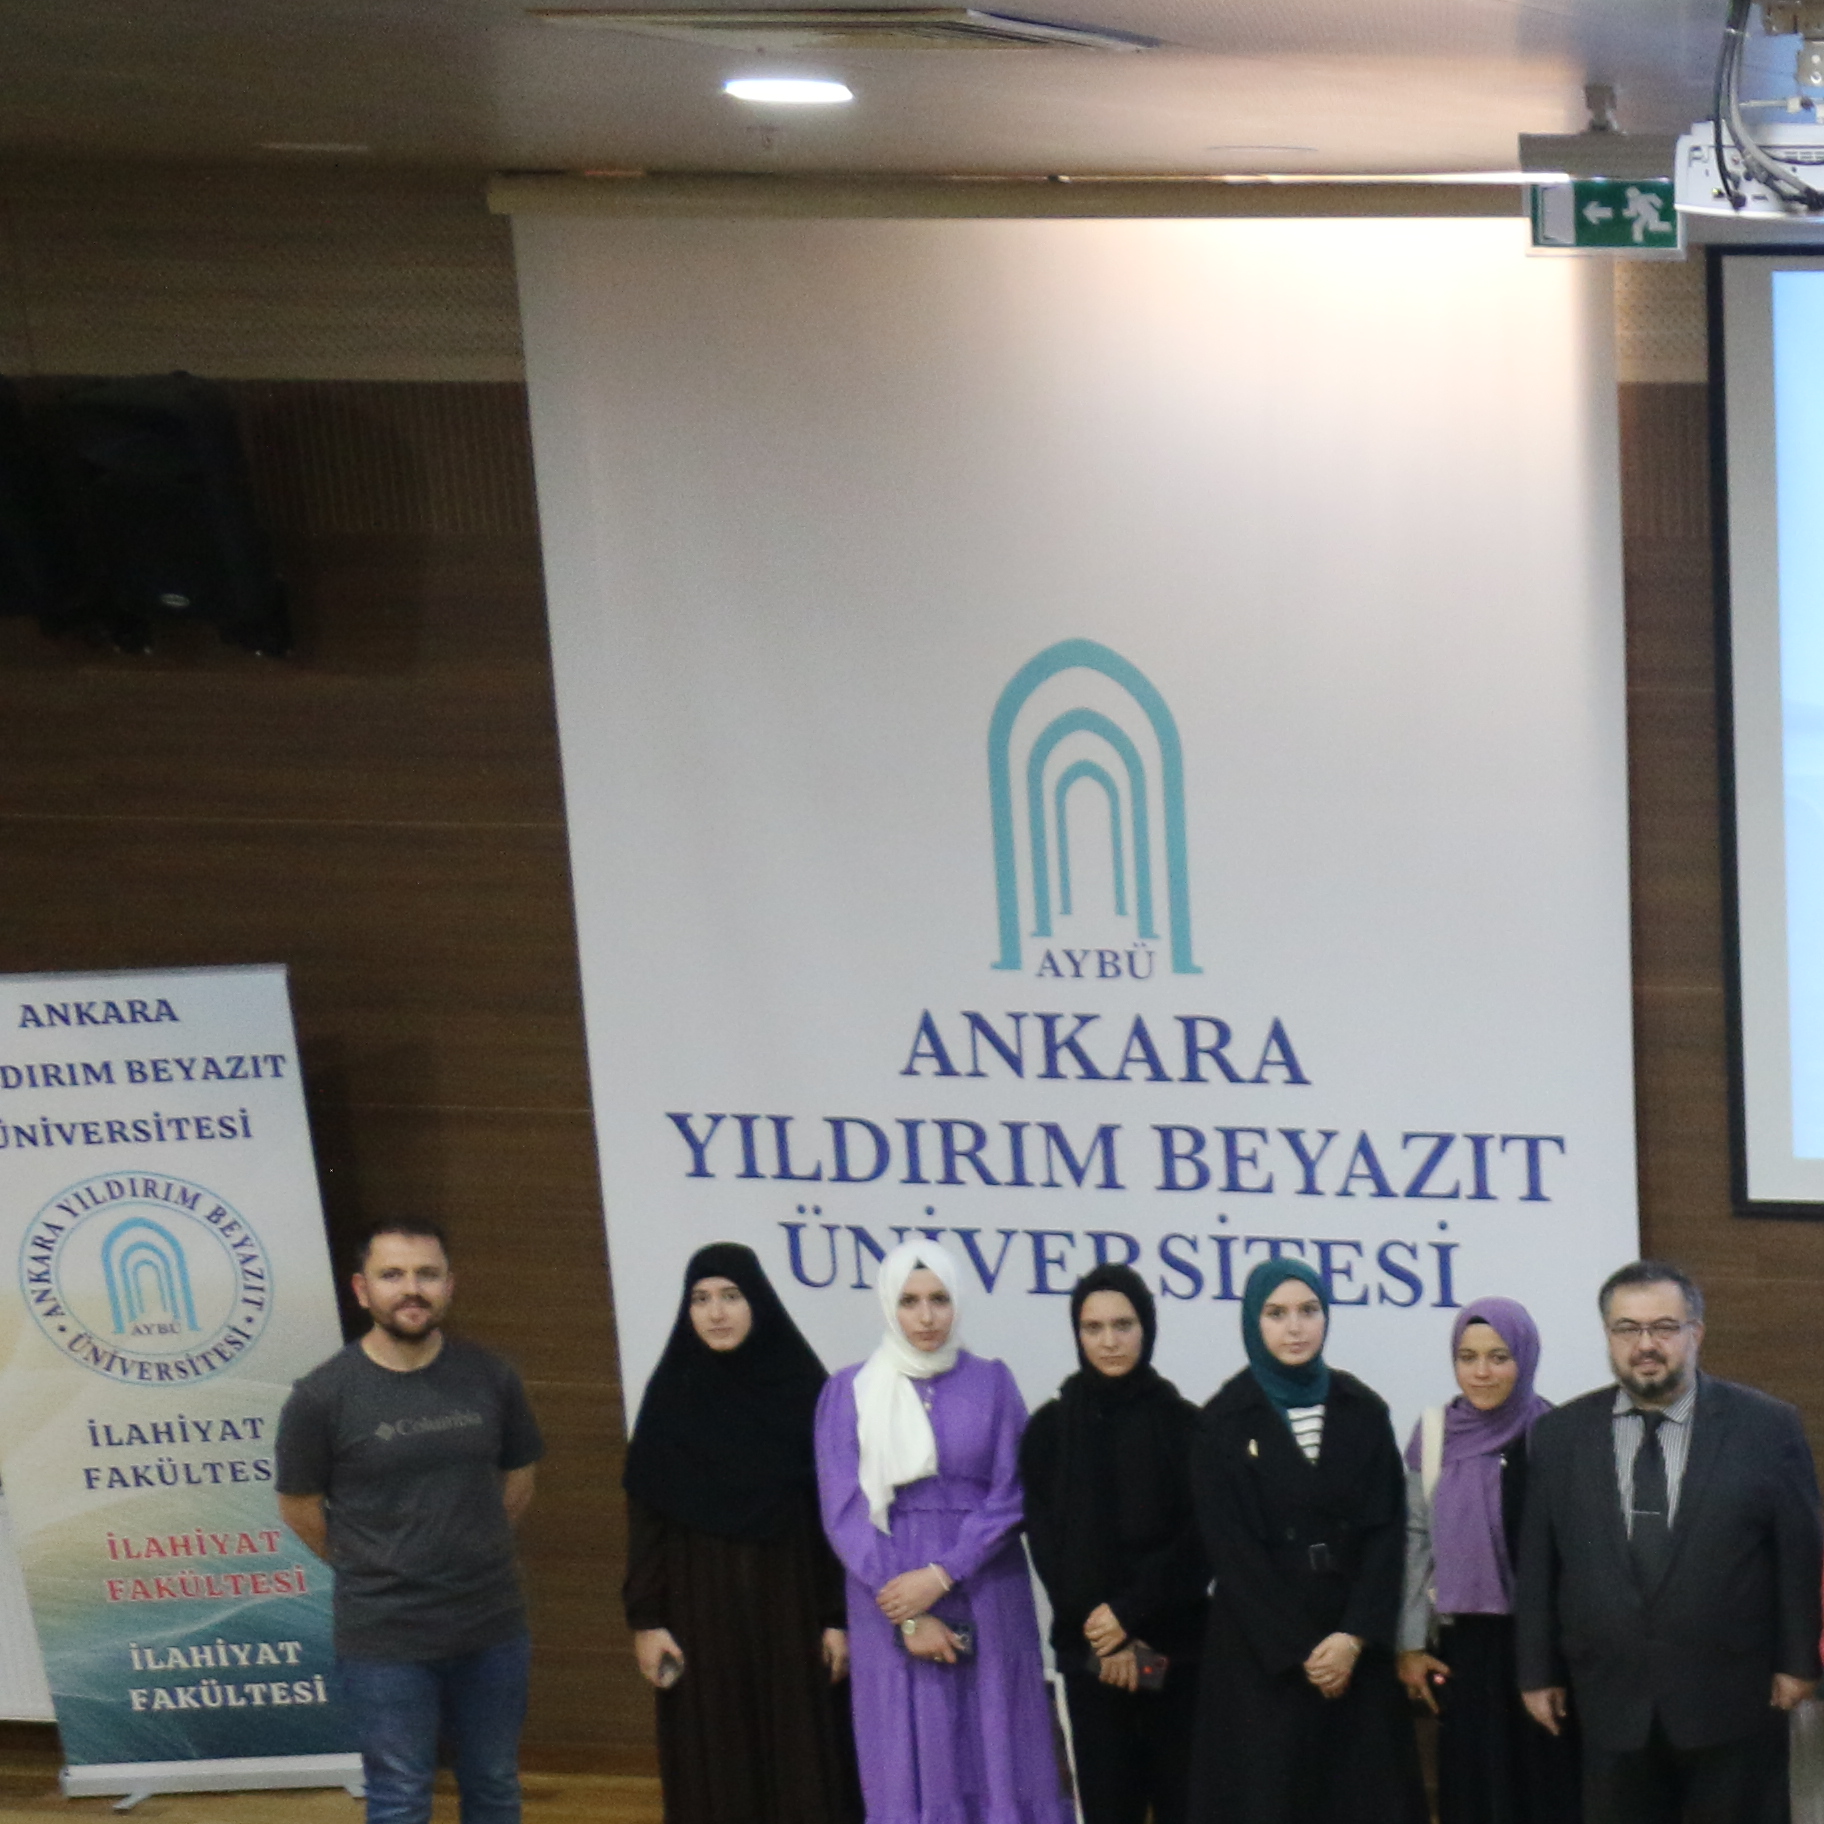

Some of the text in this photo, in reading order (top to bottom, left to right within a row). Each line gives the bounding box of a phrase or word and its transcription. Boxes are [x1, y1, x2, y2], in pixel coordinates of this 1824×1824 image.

[1035, 940, 1156, 981] AYBÜ
[18, 998, 181, 1029] ANKARA
[900, 1008, 1310, 1086] ANKARA
[124, 1054, 287, 1084] BEYAZIT
[666, 1110, 1566, 1201] YILDIRIM BEYAZIT
[27, 1177, 266, 1319] ANKARA YILDIRIM BEYAZIT
[67, 1324, 252, 1382] ÜNİVERSİTESİ
[87, 1413, 264, 1447] İLAHİYAT
[83, 1457, 273, 1490] FAKÜLTES
[105, 1528, 281, 1561] İLAHİYAT
[105, 1564, 308, 1602] FAKÜLTESİ
[128, 1637, 302, 1671] İLAHİYAT
[128, 1674, 328, 1712] FAKÜLTESİ
